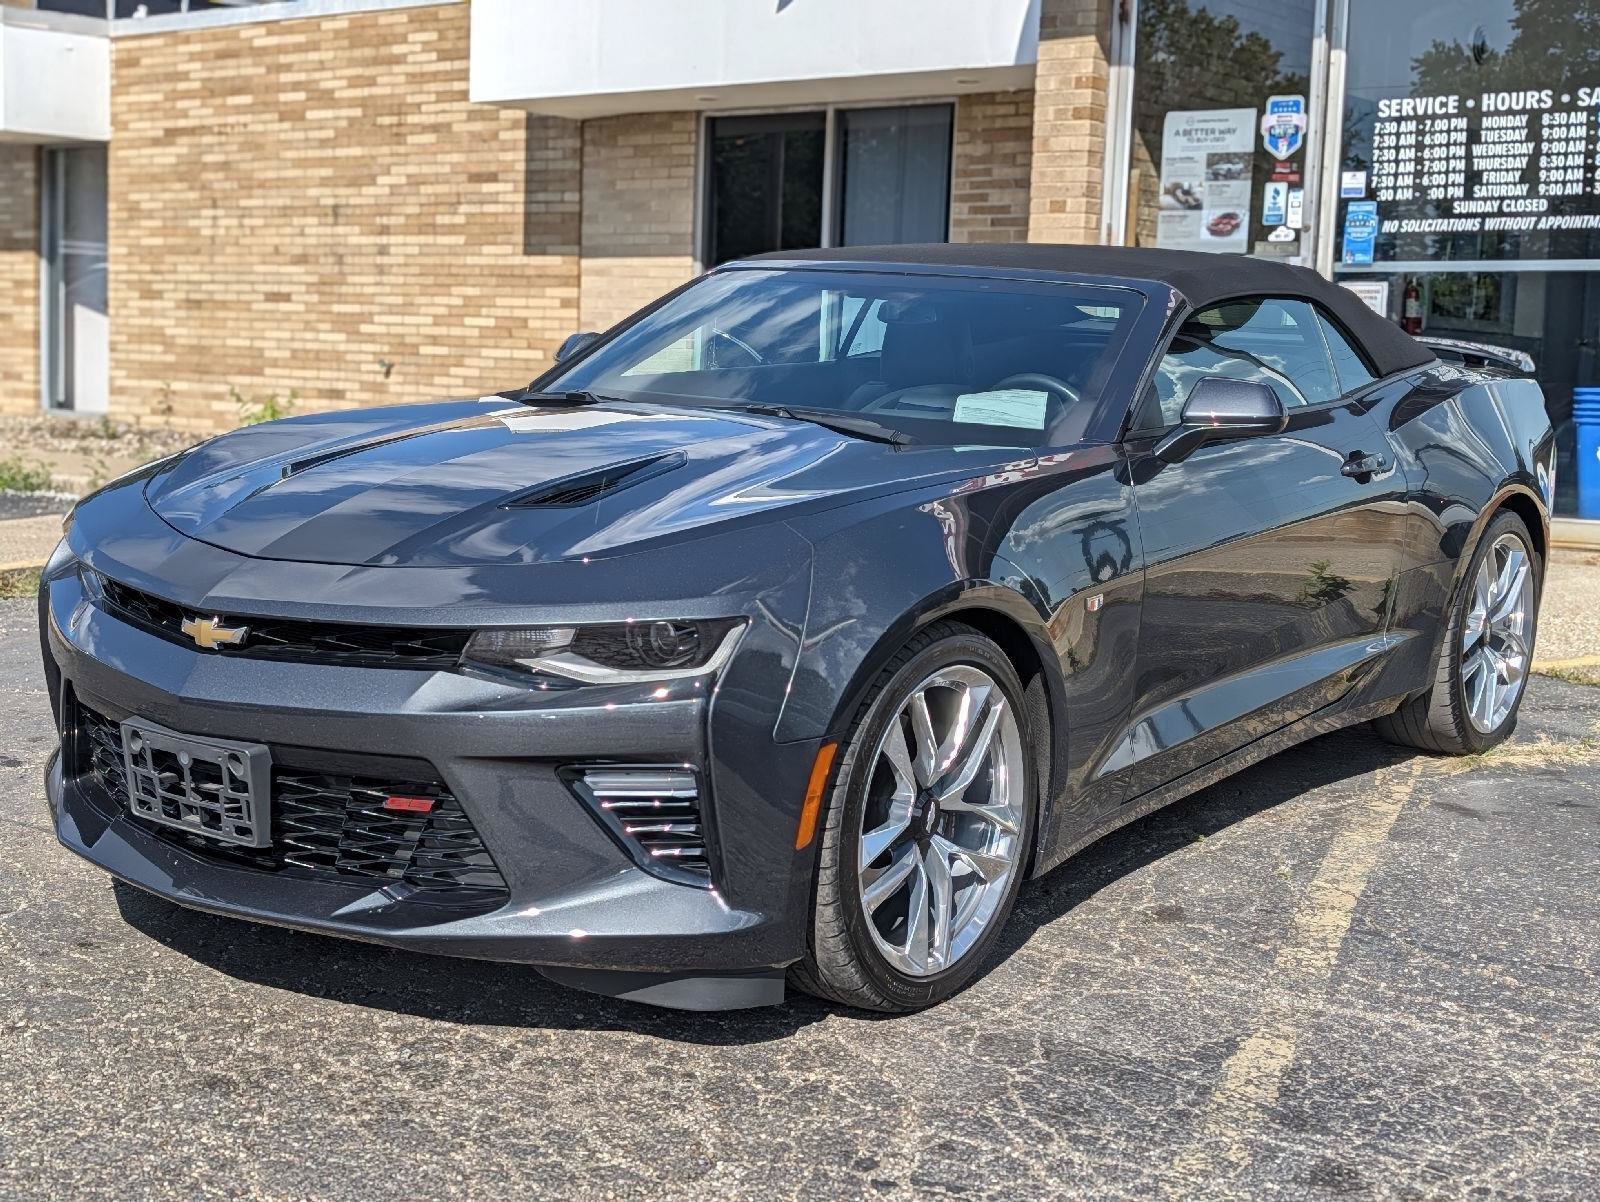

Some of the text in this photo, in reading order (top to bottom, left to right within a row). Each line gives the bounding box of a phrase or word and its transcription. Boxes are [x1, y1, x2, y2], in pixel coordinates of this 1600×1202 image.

[1378, 95, 1459, 118] SERVICE
[1482, 89, 1553, 112] HOURS
[1174, 126, 1238, 137] A BETTER WAY
[1374, 121, 1398, 134] 7:30
[1399, 120, 1417, 133] AM
[1450, 117, 1468, 130] PM
[1482, 114, 1529, 129] MONDAY
[1542, 112, 1568, 126] 8:30
[1569, 111, 1588, 124] AM
[1373, 134, 1397, 148] 7:30
[1399, 133, 1416, 147] AM
[1423, 132, 1449, 145] 6:00
[1449, 131, 1467, 144] PM
[1480, 128, 1528, 143] TUESDAY
[1541, 126, 1567, 140] 9:00
[1568, 125, 1587, 139] AM
[1372, 149, 1396, 162] 7:30
[1398, 147, 1416, 160] AM
[1423, 147, 1448, 159] 6:00
[1449, 145, 1466, 158] PM
[1472, 142, 1535, 157] WEDNESDAY
[1541, 141, 1567, 154] 9:00
[1567, 140, 1586, 153] AM
[1372, 162, 1396, 175] 7:30
[1397, 160, 1415, 174] AM
[1423, 160, 1447, 173] 7:00
[1448, 158, 1466, 172] PM
[1473, 156, 1529, 171] THURSDAY
[1539, 155, 1565, 168] 8:30
[1565, 154, 1585, 167] AM
[1371, 175, 1395, 188] 7:30
[1396, 174, 1414, 187] AM
[1422, 173, 1446, 187] 6:00
[1447, 172, 1465, 185] PM
[1482, 170, 1522, 184] FRIDAY
[1539, 169, 1565, 182] 9:00
[1565, 168, 1584, 181] AM
[1395, 187, 1413, 200] AM
[1446, 185, 1464, 199] PM
[1472, 183, 1529, 198] SATURDAY
[1538, 183, 1564, 196] 9:00
[1564, 182, 1583, 195] AM
[1452, 198, 1549, 214] SUNDAY CLOSED
[1381, 219, 1400, 233] NO
[1400, 217, 1482, 233] SOLICITATIONS
[1483, 216, 1537, 231] WITHOUT
